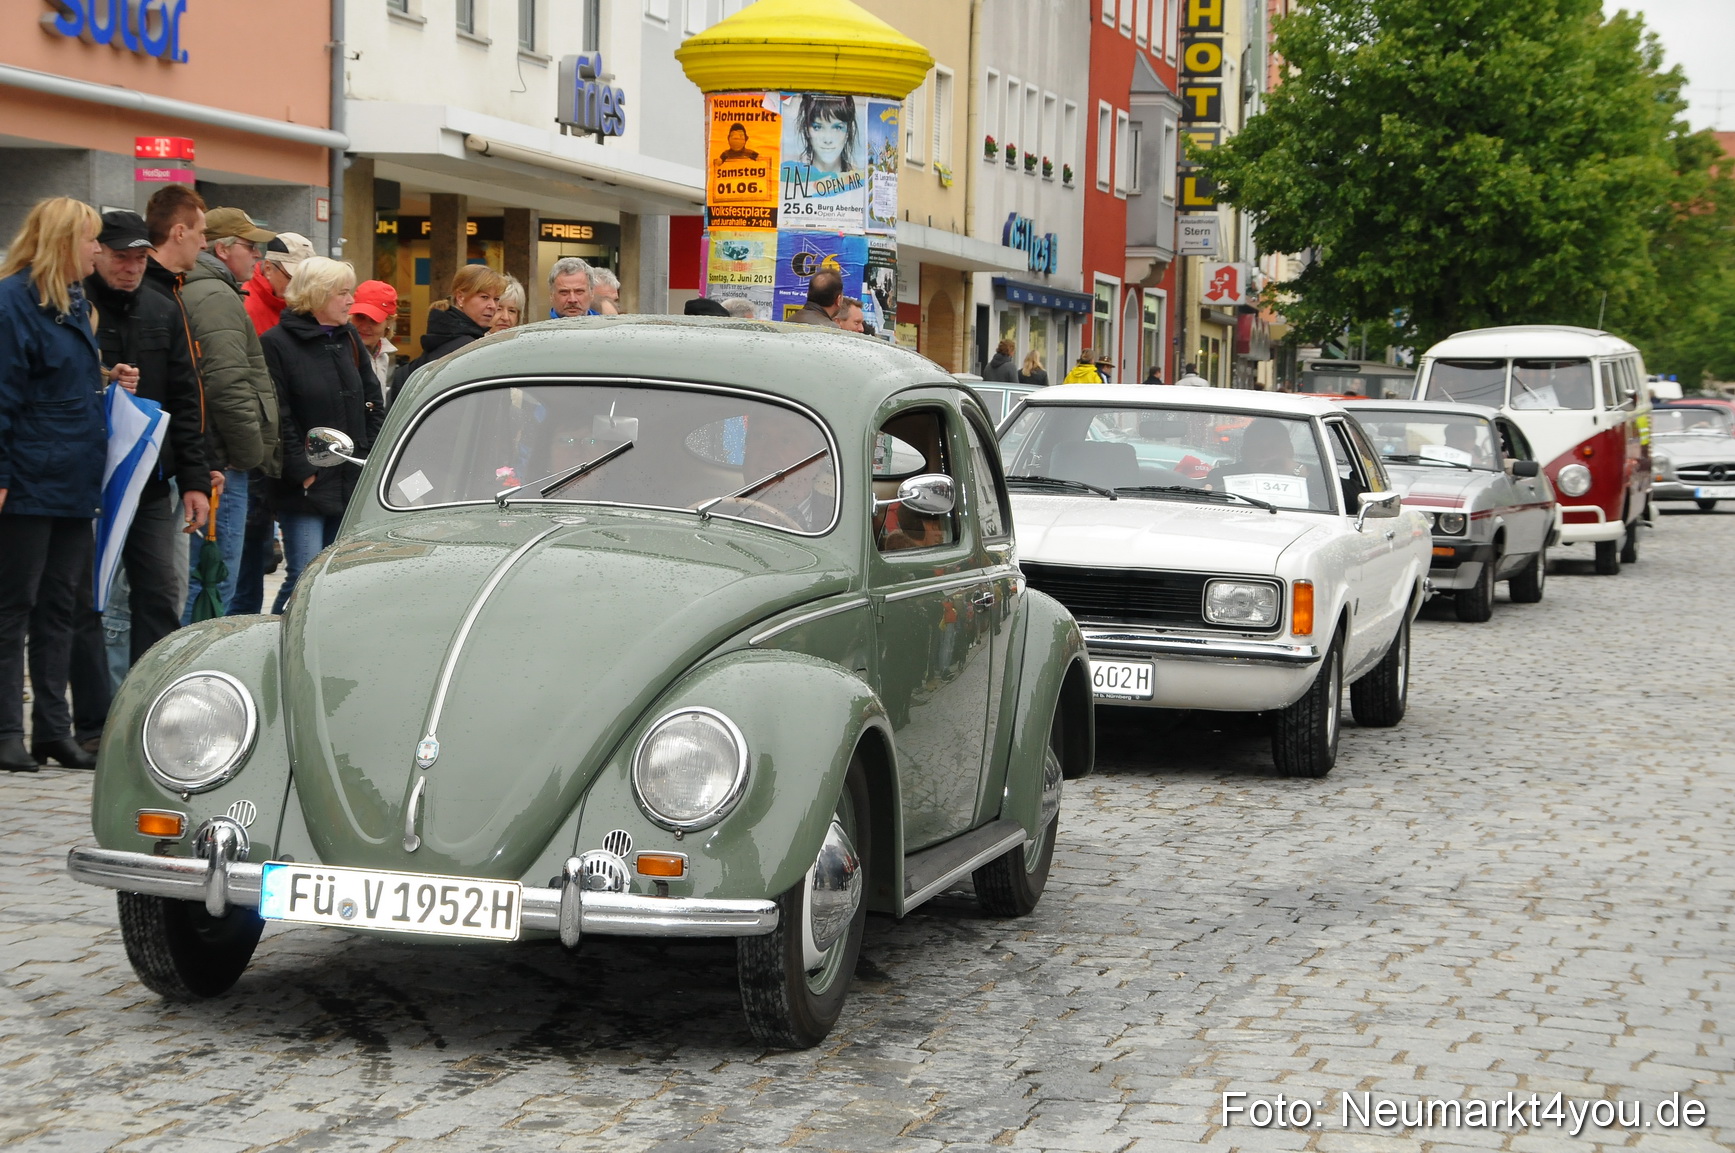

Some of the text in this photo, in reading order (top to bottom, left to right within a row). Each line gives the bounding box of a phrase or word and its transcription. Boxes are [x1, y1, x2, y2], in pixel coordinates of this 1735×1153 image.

[574, 52, 625, 136] fries
[1184, 0, 1221, 206] HOTEL
[713, 111, 777, 122] Flohmarkt
[717, 167, 766, 178] Samstag
[717, 182, 763, 194] 01.06.
[783, 165, 812, 200] ZAZ
[816, 177, 845, 196] OPEN
[848, 173, 863, 190] AIR
[711, 206, 770, 218] Volksfestplatz
[783, 203, 817, 215] 25.6.
[818, 204, 834, 212] Burg
[711, 218, 720, 226] und
[541, 223, 593, 239] FRIES
[1184, 226, 1211, 236] Stern
[730, 273, 736, 282] 2.
[737, 274, 752, 283] Juni
[754, 274, 773, 284] 2013
[1263, 481, 1290, 492] 347
